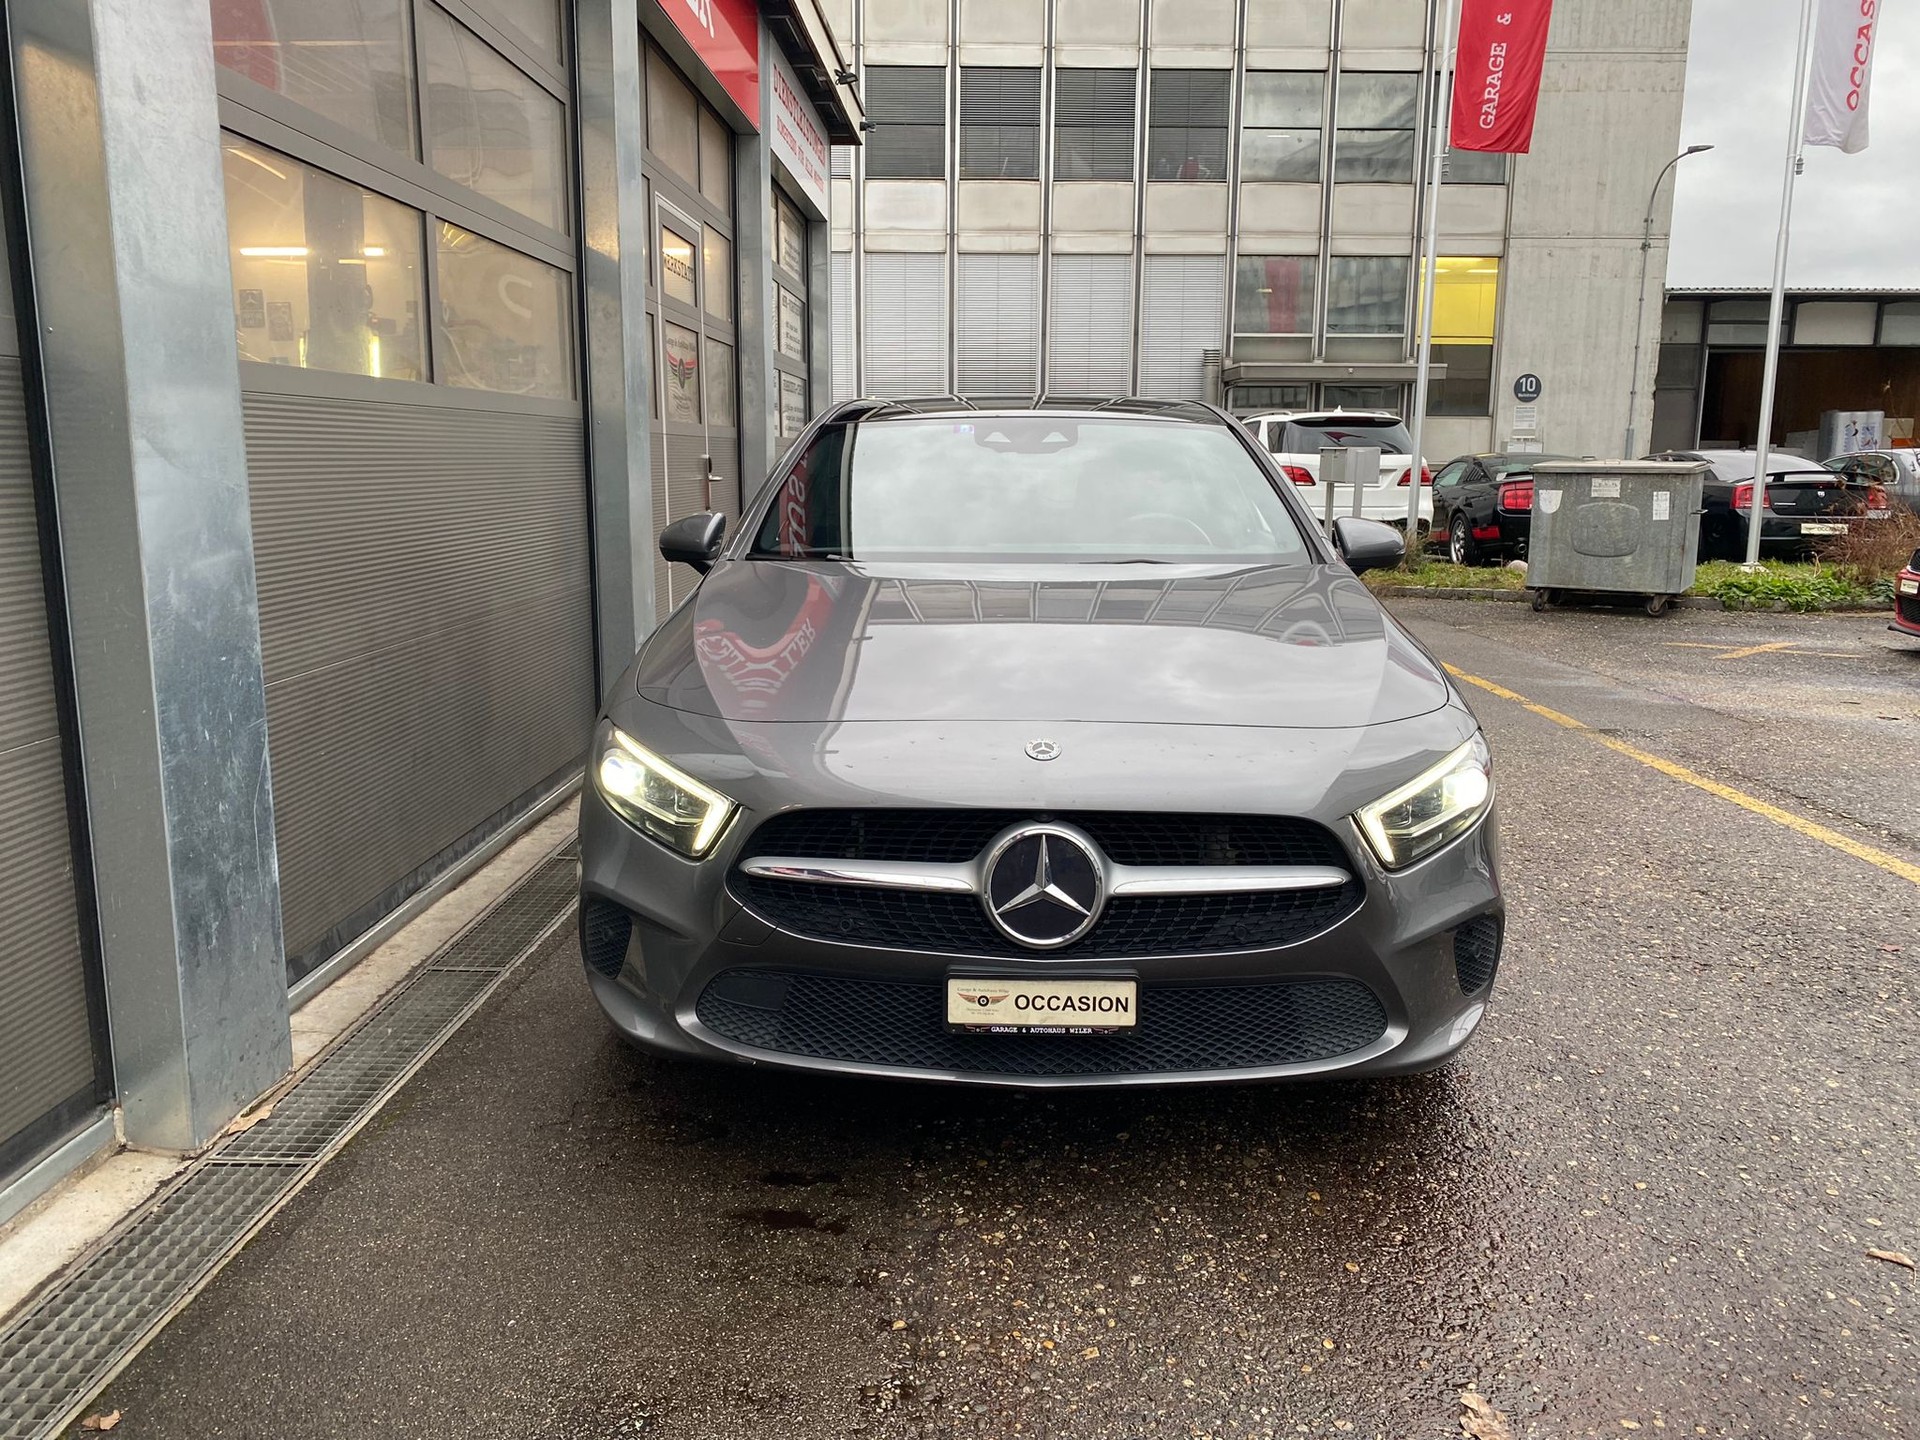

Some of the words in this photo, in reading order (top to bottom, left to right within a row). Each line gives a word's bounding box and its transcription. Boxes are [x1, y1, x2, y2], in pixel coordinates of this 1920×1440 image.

[1479, 43, 1507, 129] GARAGE
[1497, 13, 1512, 25] &
[1846, 0, 1875, 111] OCCAS
[1519, 377, 1537, 392] 10
[1014, 994, 1129, 1013] OCCASION
